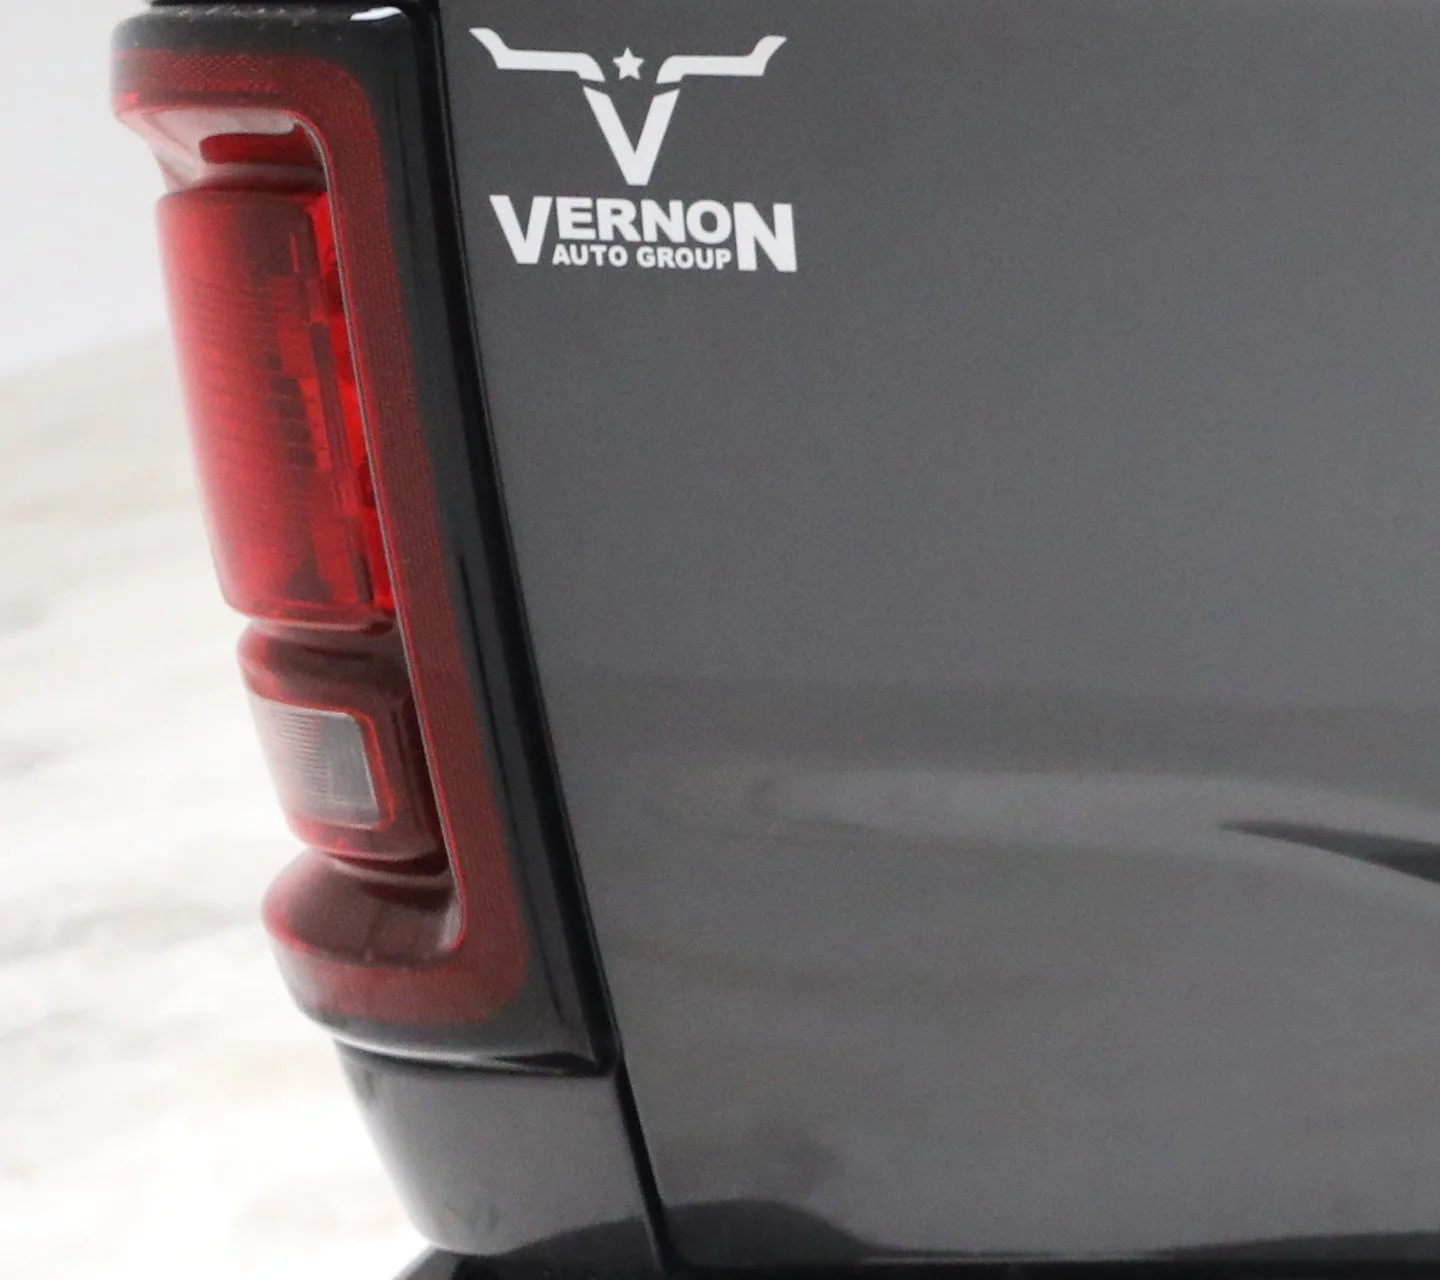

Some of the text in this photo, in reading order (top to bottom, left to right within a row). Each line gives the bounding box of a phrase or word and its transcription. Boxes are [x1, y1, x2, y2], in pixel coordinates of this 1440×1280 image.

[489, 194, 798, 273] VERNON
[552, 243, 733, 271] AUTO GROUP
